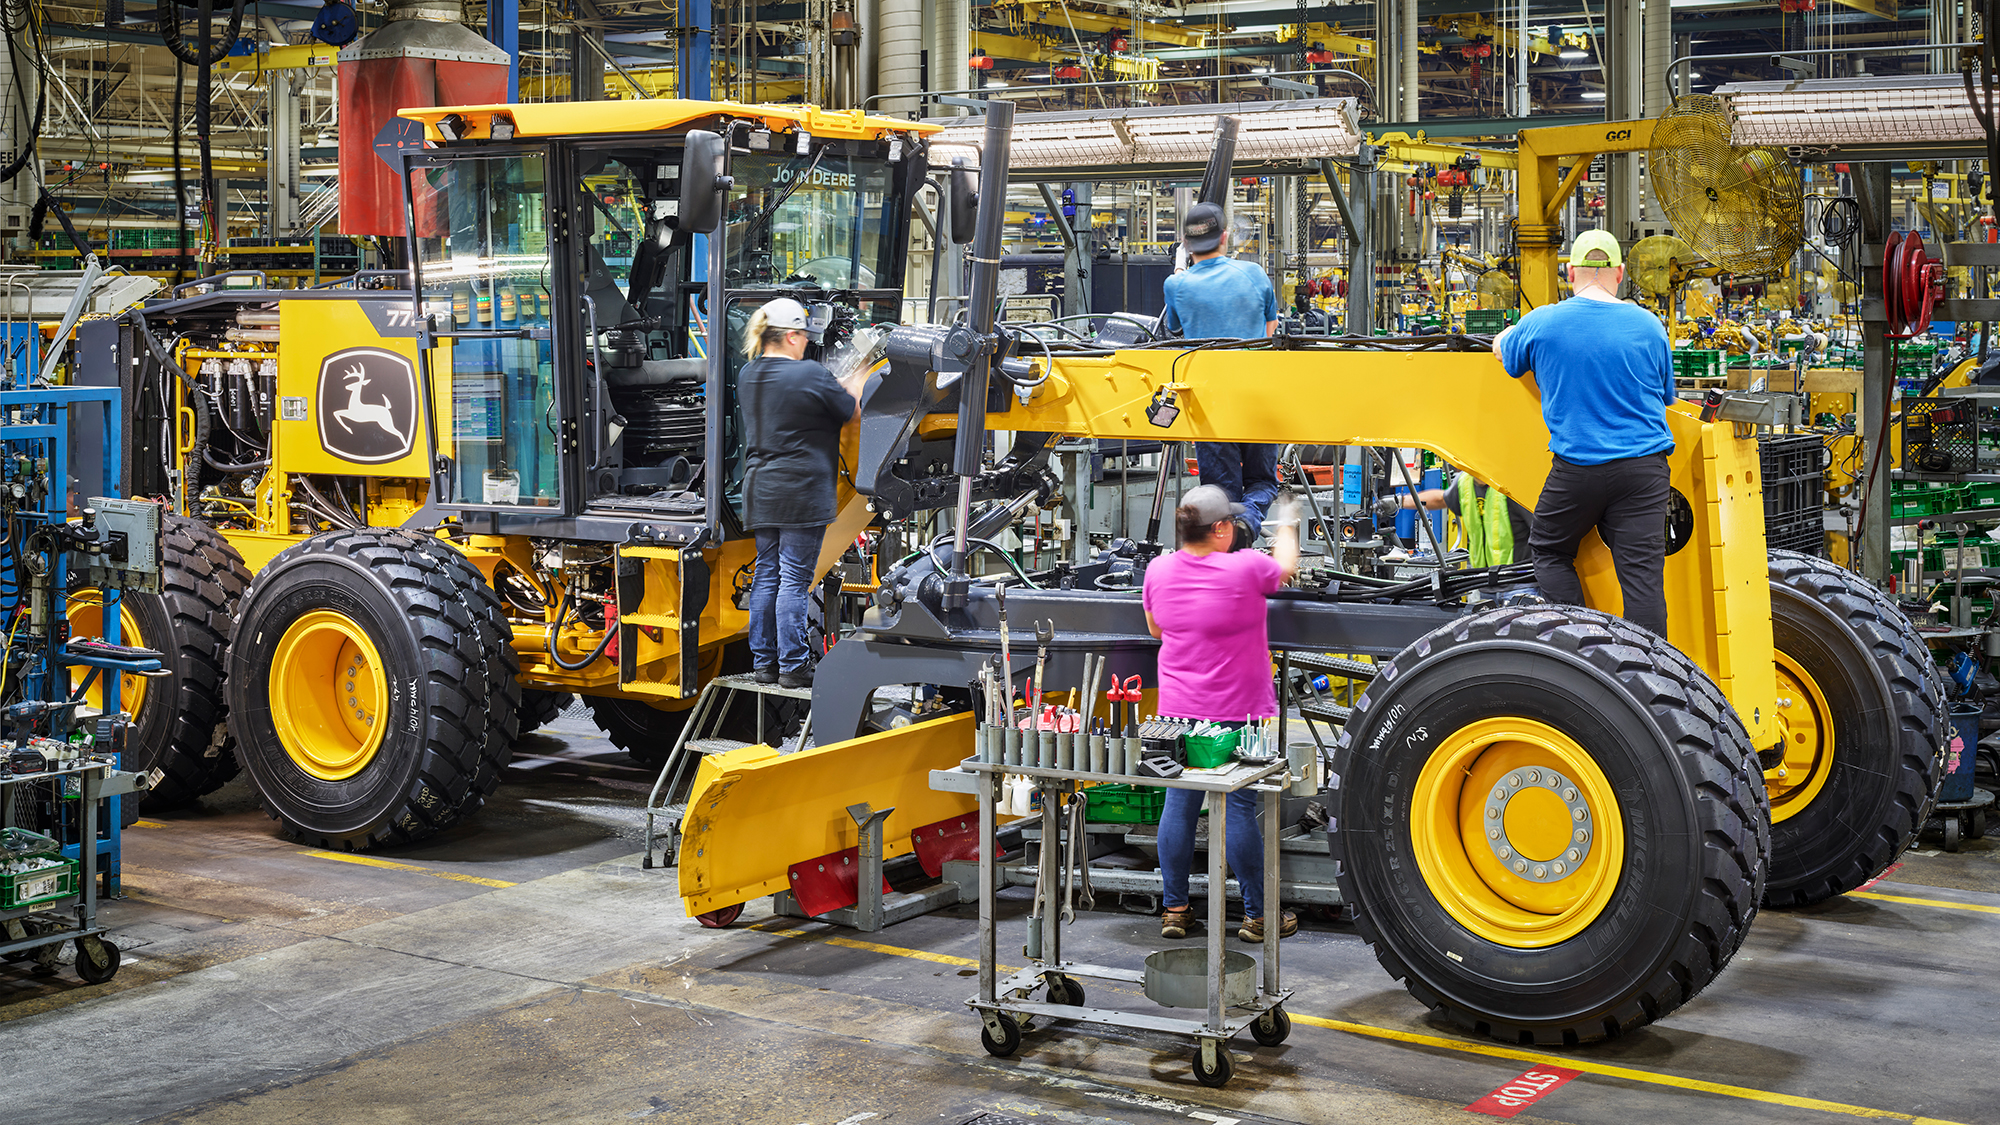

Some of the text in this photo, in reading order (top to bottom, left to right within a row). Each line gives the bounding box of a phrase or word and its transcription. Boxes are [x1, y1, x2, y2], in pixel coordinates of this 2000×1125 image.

[1606, 130, 1631, 141] GCI
[812, 168, 856, 187] DEERE
[1597, 807, 1648, 945] MICHELIN
[1492, 1072, 1560, 1106] STOP
